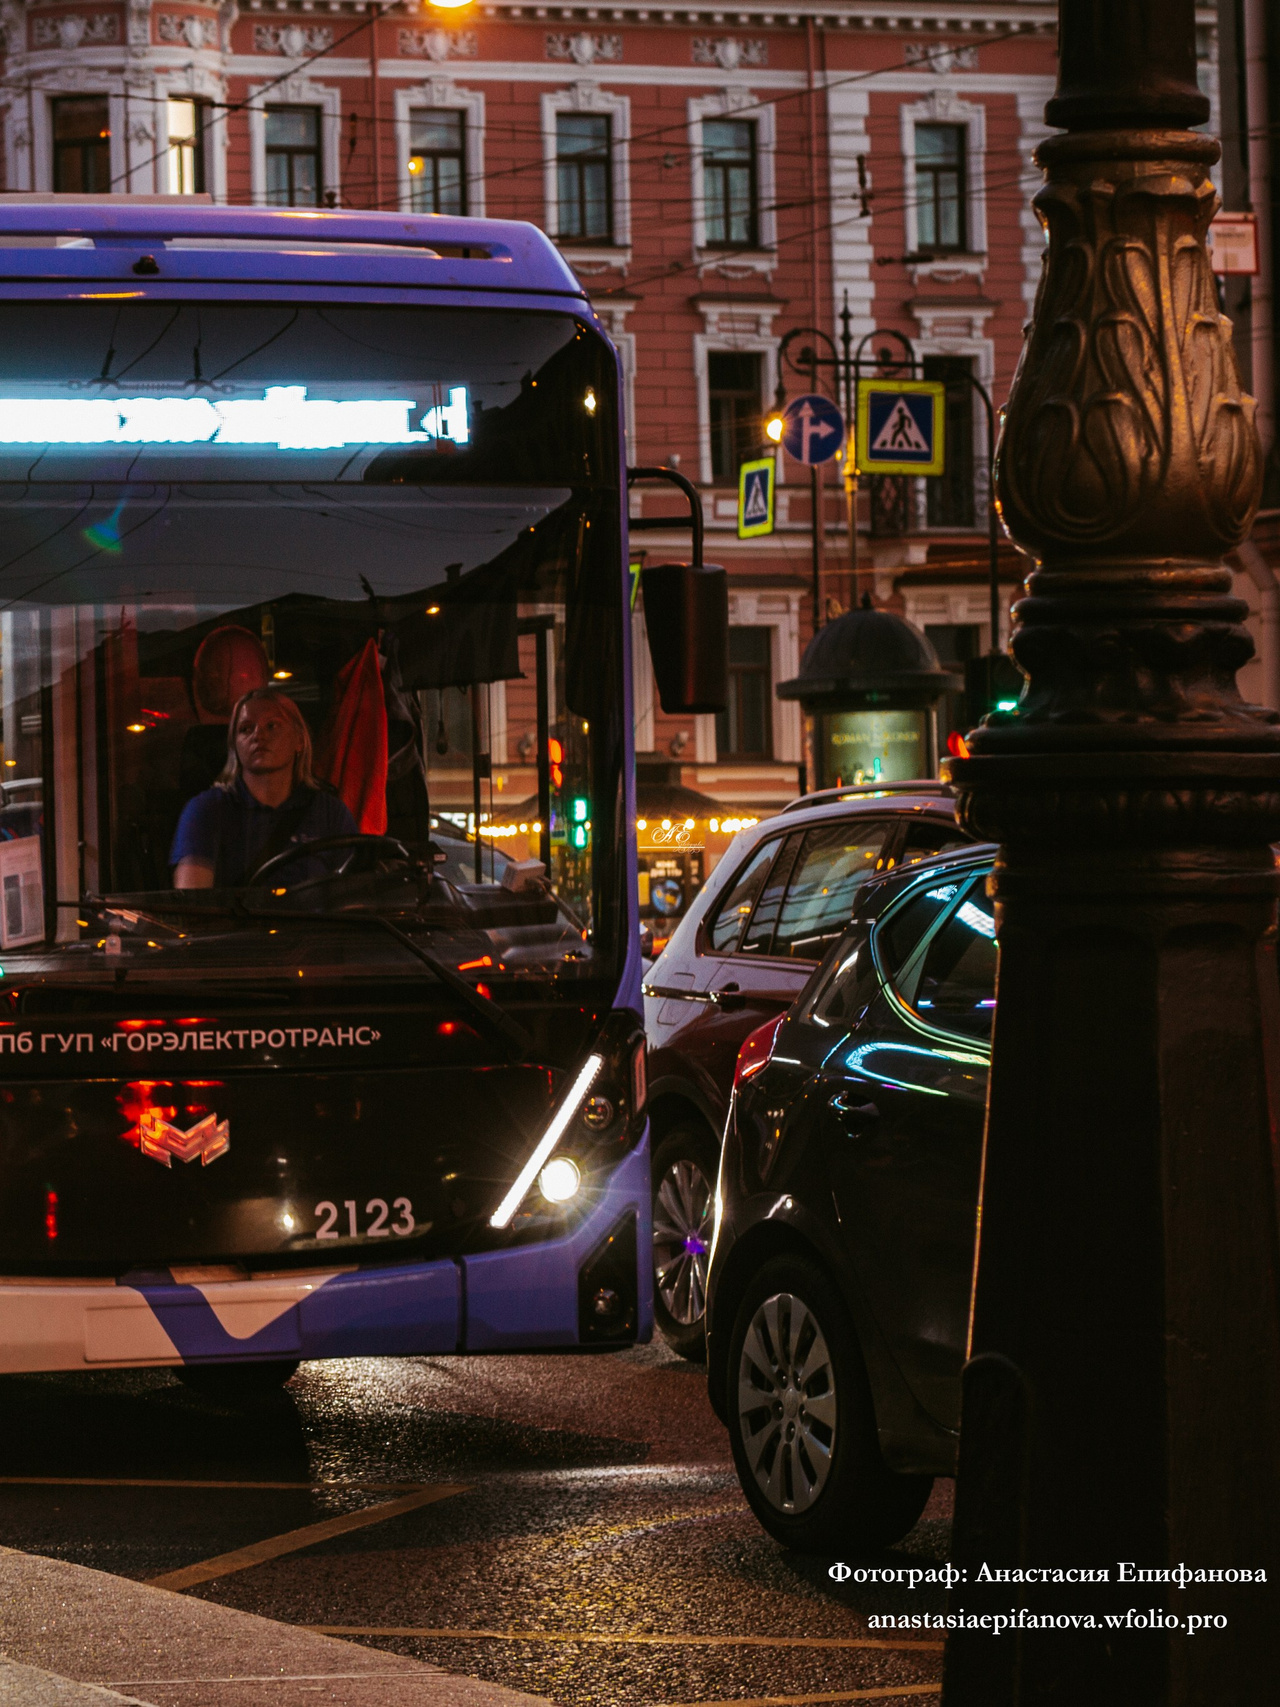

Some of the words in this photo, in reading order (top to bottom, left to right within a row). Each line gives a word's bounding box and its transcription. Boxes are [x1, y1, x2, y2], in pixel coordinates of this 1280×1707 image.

[41, 1033, 93, 1053] ГУП
[101, 1026, 381, 1052] «ГОРЭЛЕКТРОТРАНС»
[314, 1197, 415, 1240] 2123
